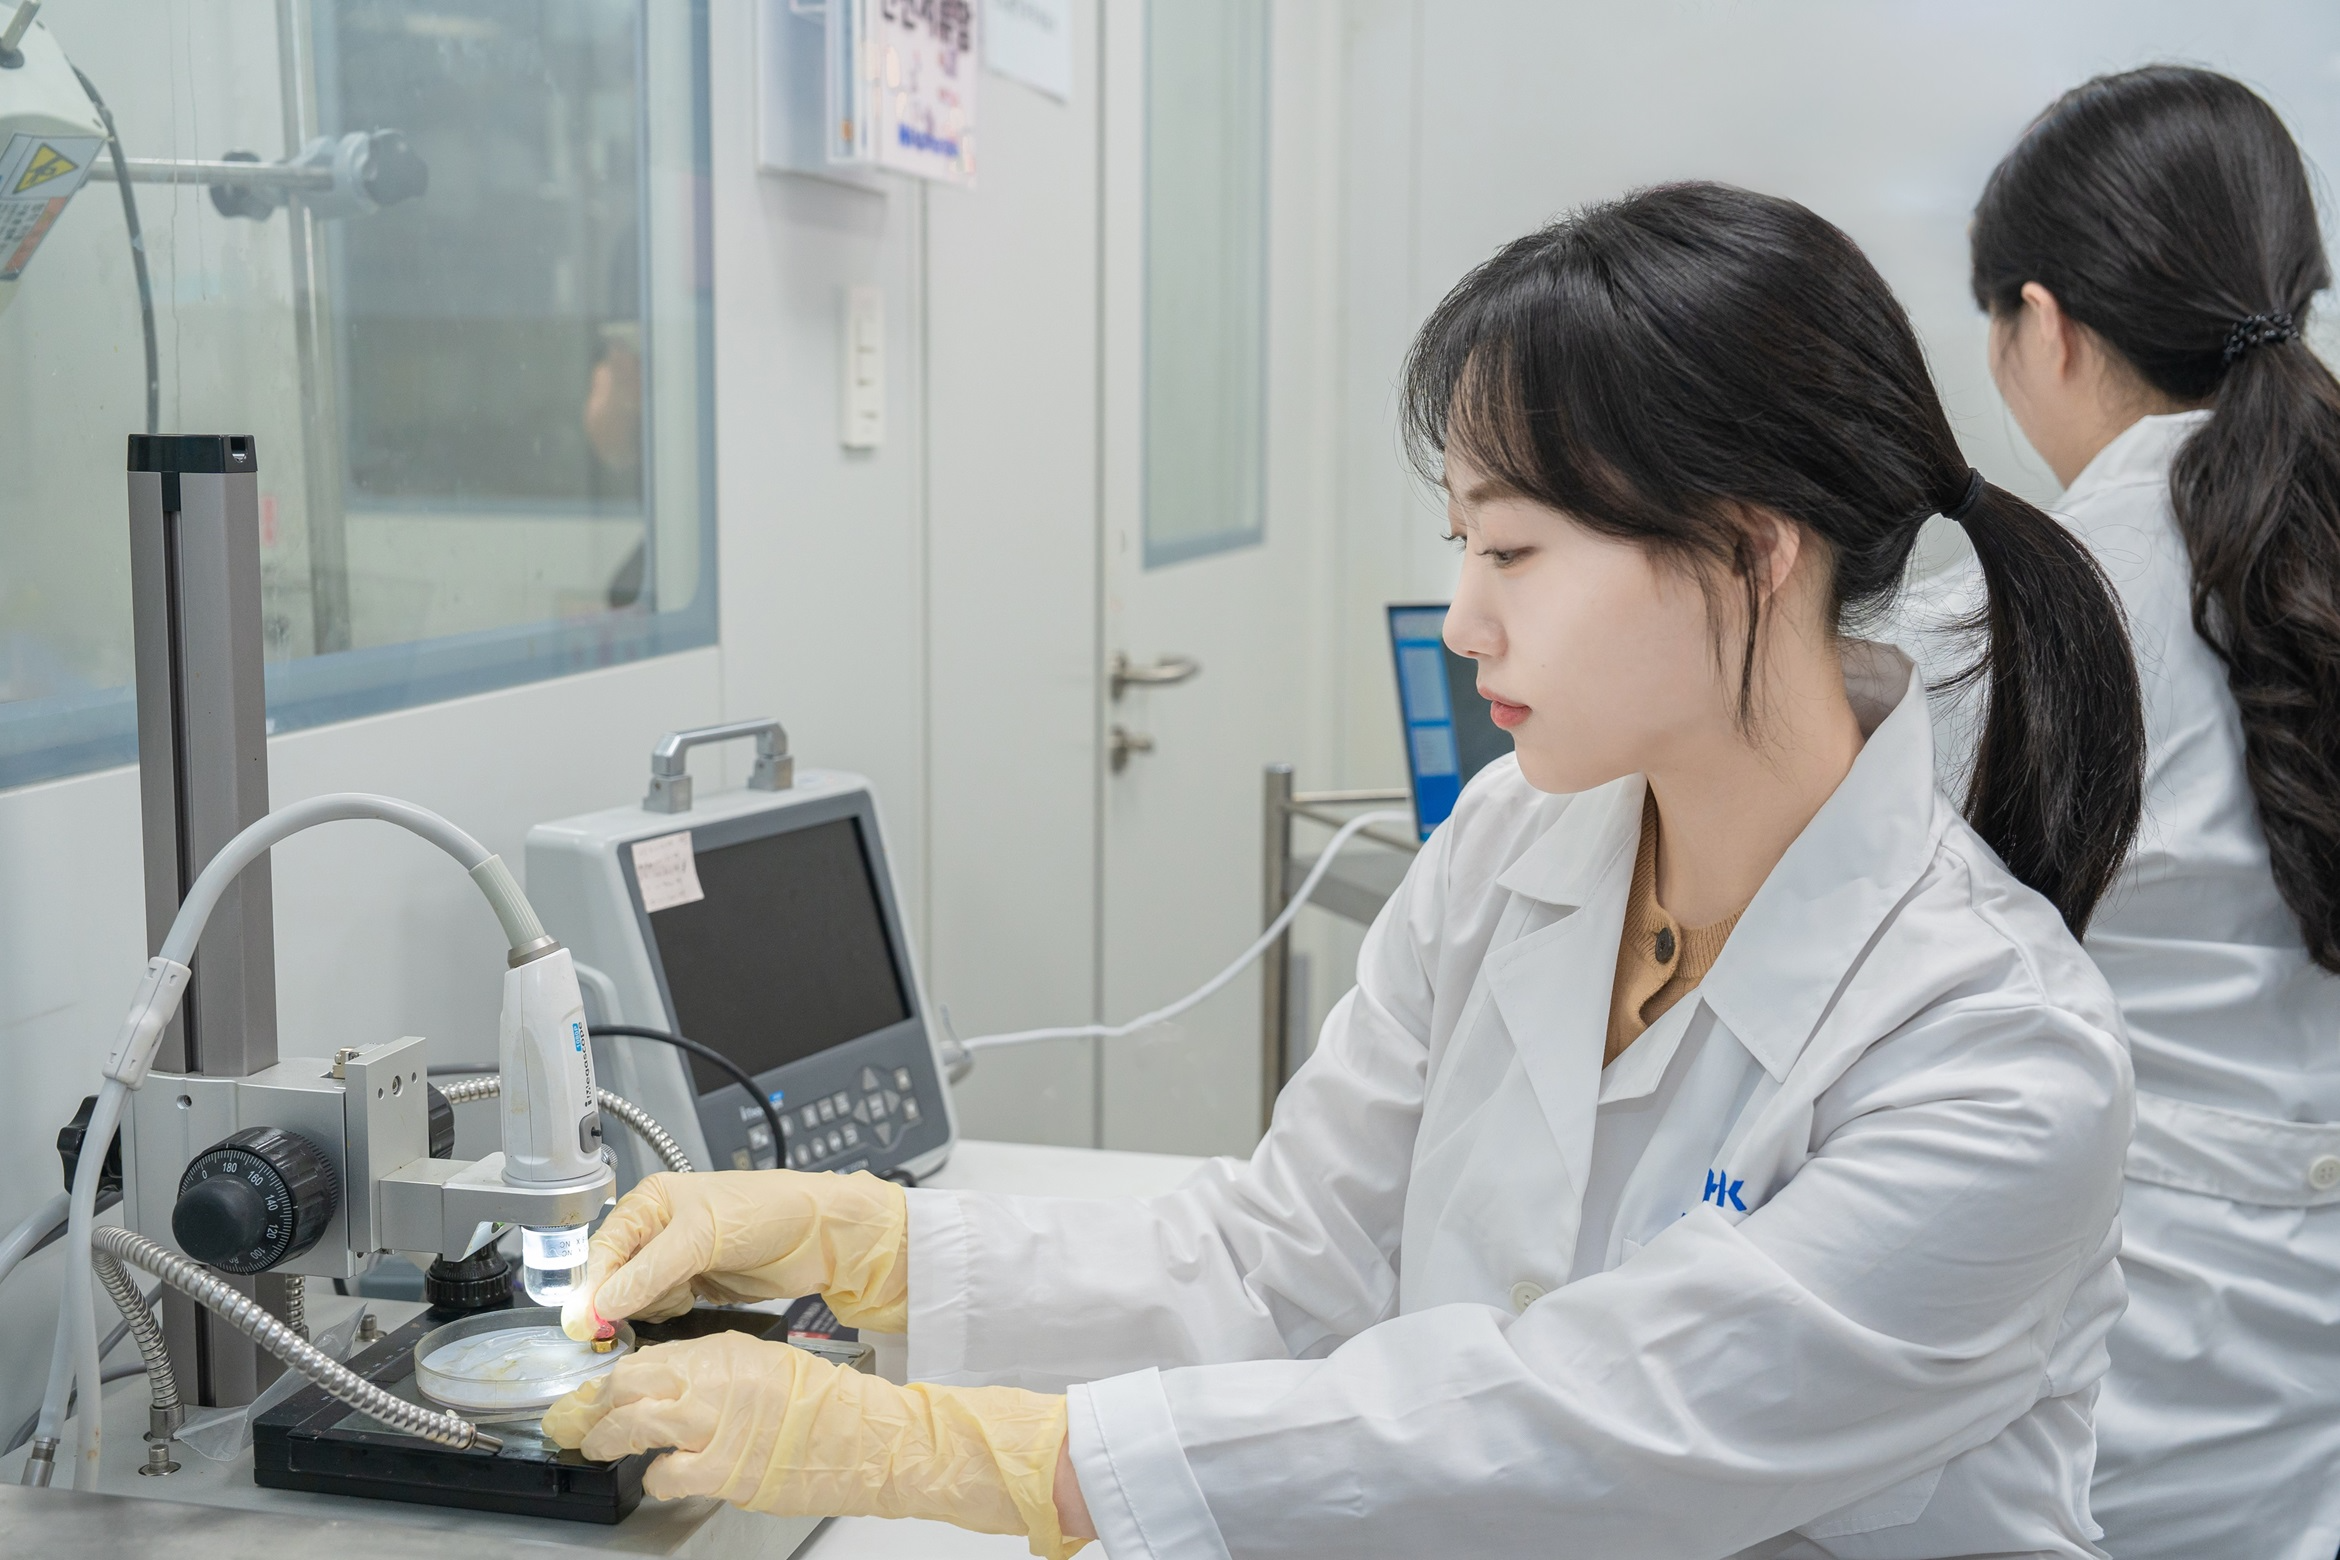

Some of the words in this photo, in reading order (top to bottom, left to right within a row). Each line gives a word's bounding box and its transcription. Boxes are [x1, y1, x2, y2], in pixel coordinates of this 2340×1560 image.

[202, 1170, 208, 1179] 0
[222, 1162, 238, 1173] 180
[247, 1171, 264, 1186] 160
[265, 1194, 279, 1211] 140
[266, 1223, 279, 1239] 120
[250, 1247, 266, 1260] 100
